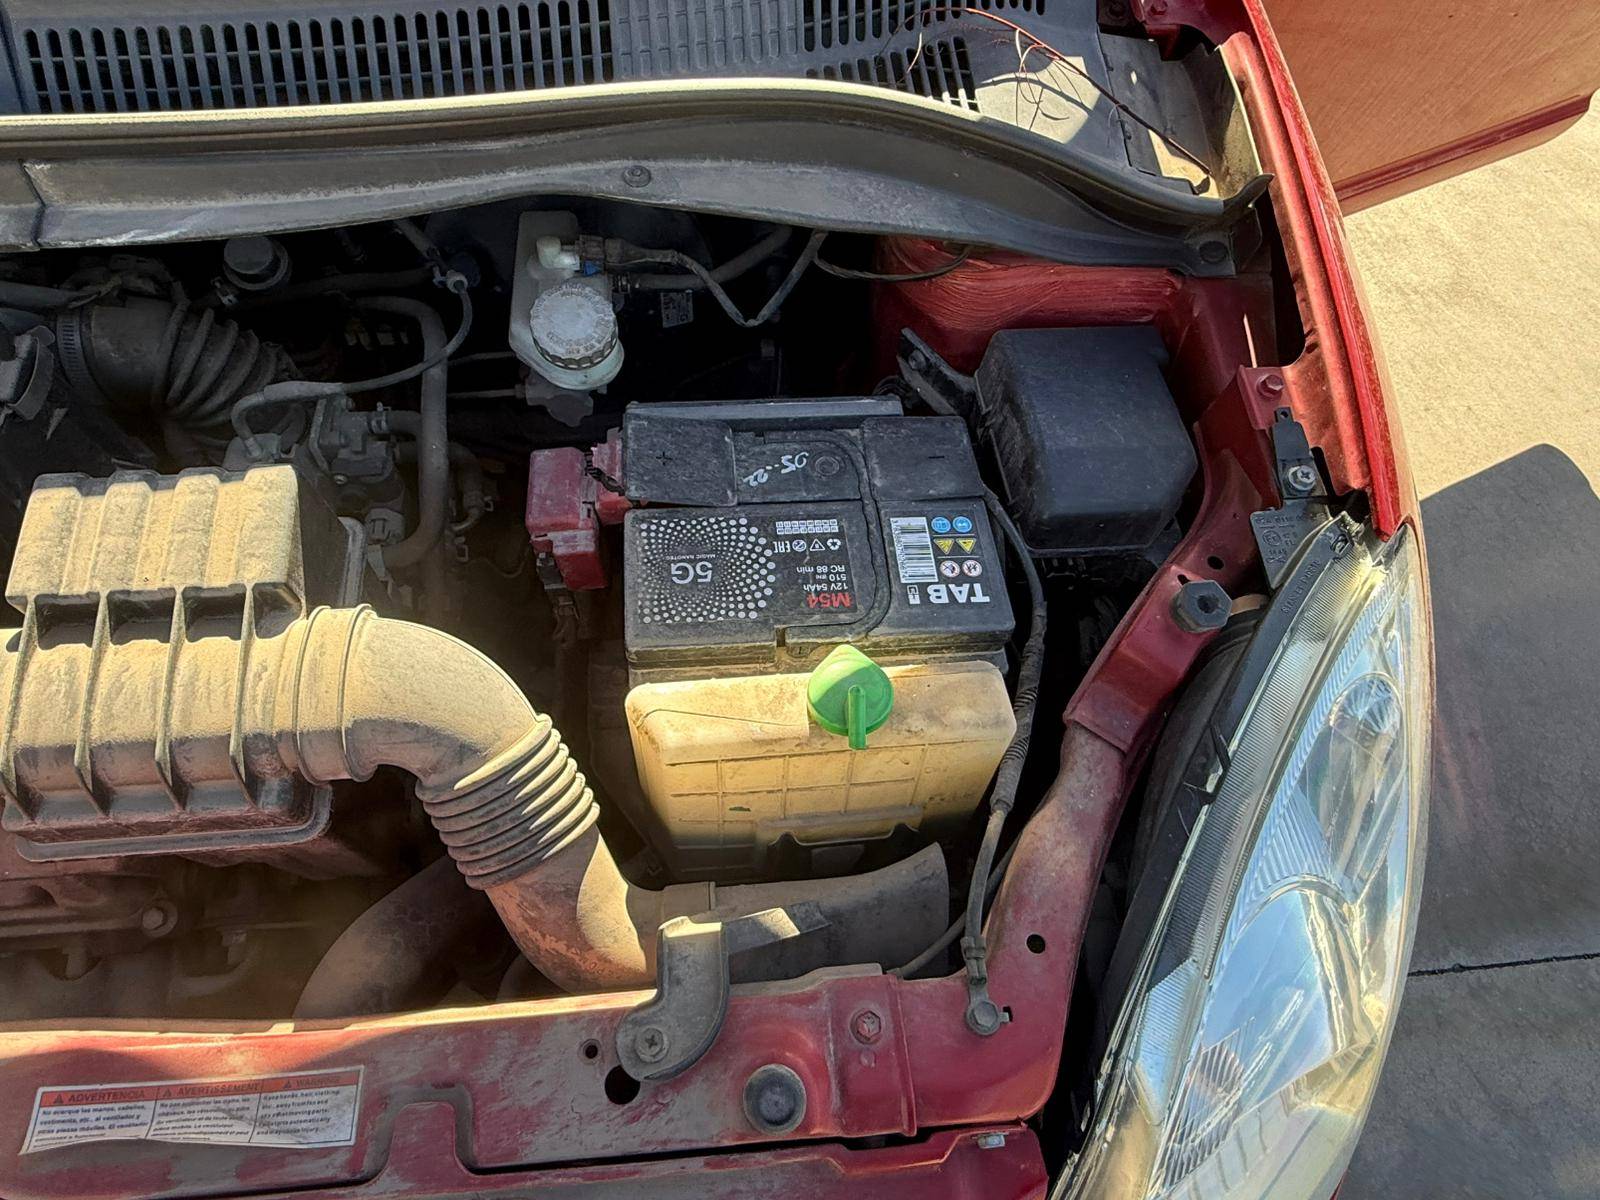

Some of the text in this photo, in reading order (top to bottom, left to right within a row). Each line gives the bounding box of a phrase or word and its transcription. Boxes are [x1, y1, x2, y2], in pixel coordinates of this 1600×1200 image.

[670, 560, 713, 585] 5G
[796, 566, 814, 574] min
[830, 565, 845, 573] RC
[829, 573, 847, 581] 510
[803, 582, 849, 592] 12V 54Ah
[926, 583, 991, 604] TAB
[806, 592, 852, 609] M54
[177, 1083, 259, 1095] AVERTISSEMENT
[68, 1091, 145, 1102] ADVERTENCIA
